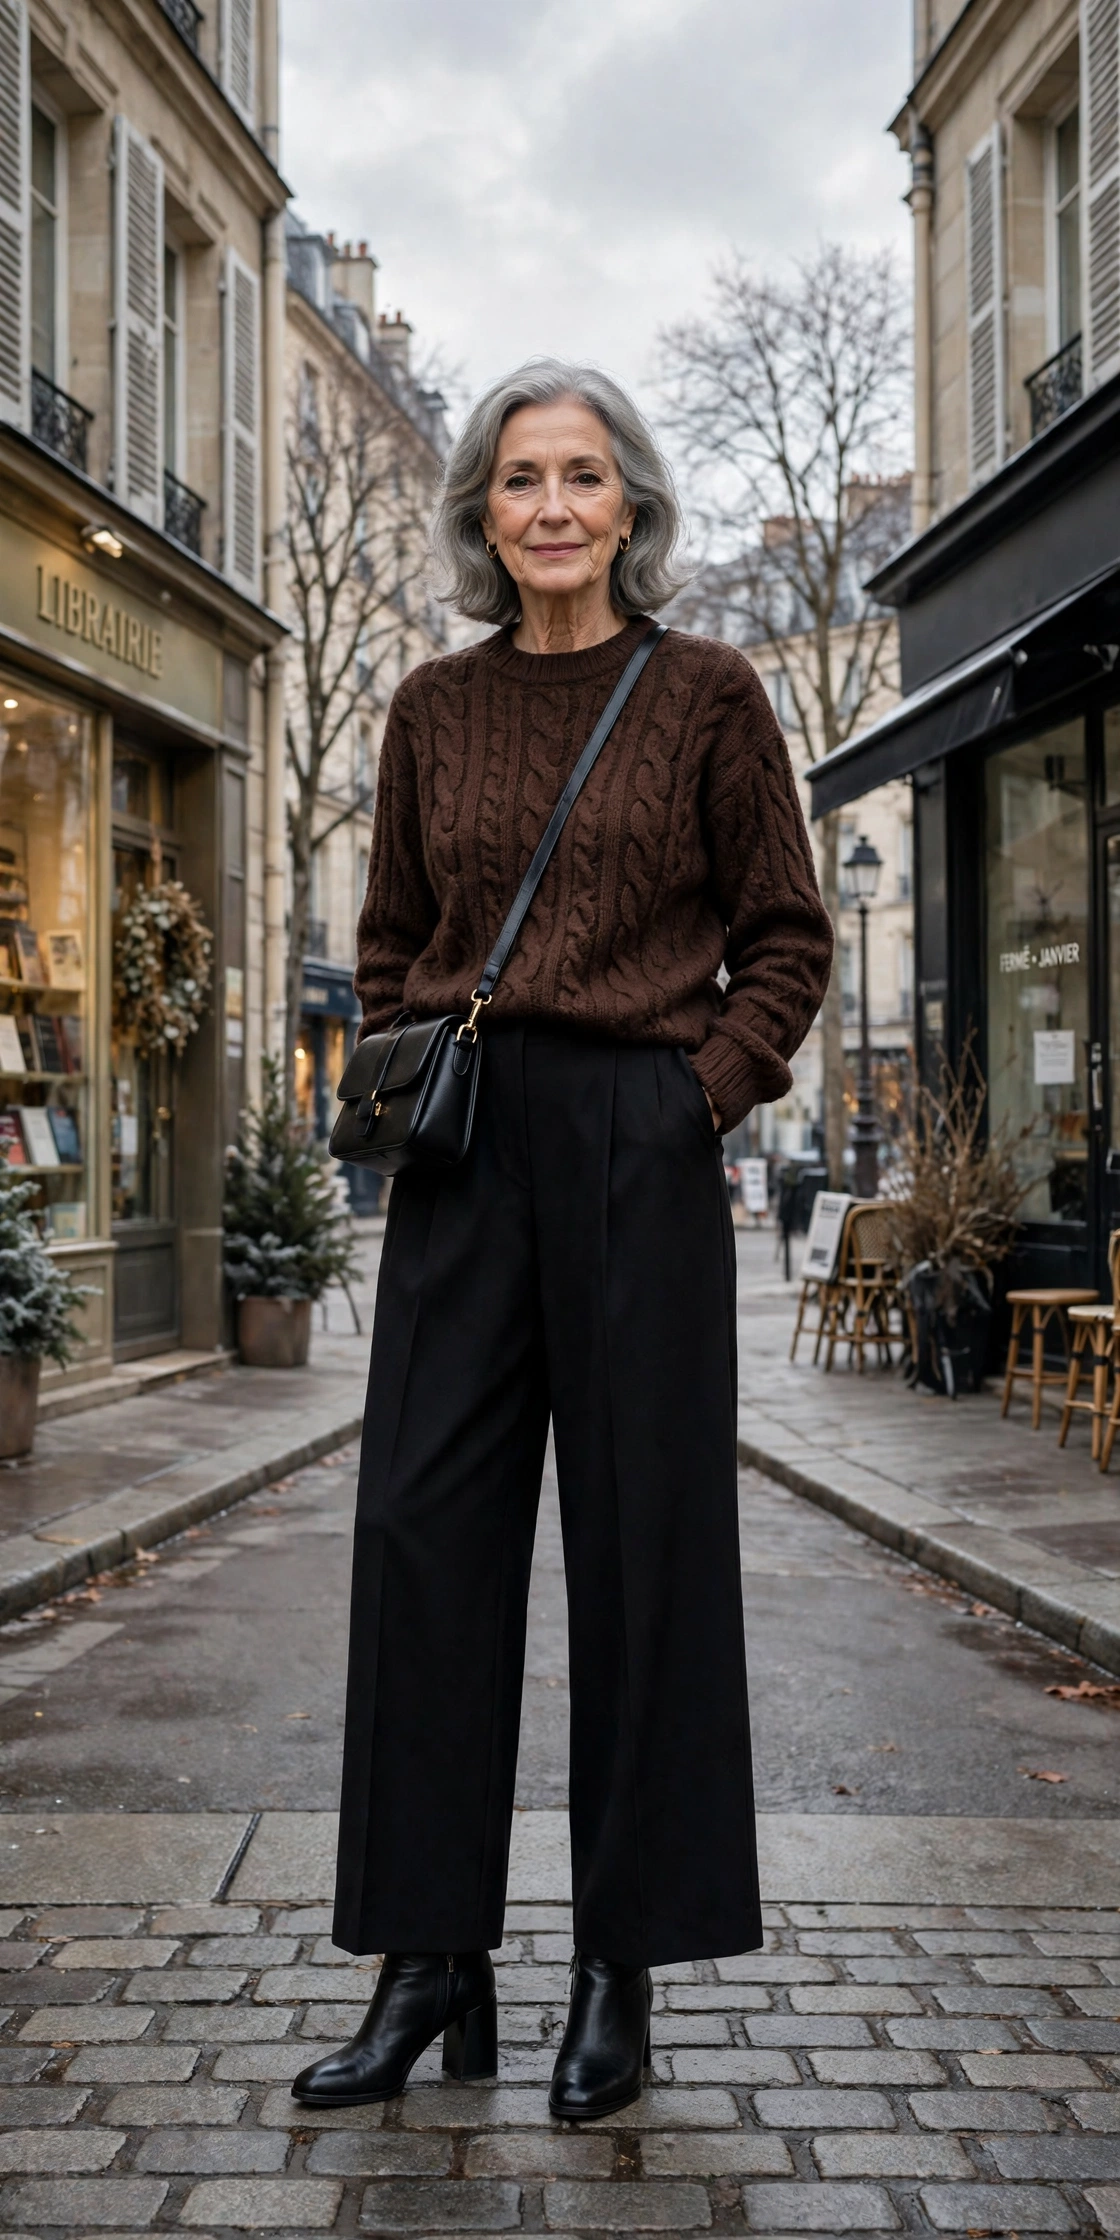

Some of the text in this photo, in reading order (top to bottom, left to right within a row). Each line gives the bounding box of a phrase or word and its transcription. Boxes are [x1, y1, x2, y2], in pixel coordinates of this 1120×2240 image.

[37, 565, 163, 679] LIBRAIRIE
[1000, 942, 1080, 973] FERMÉ JANVIER
